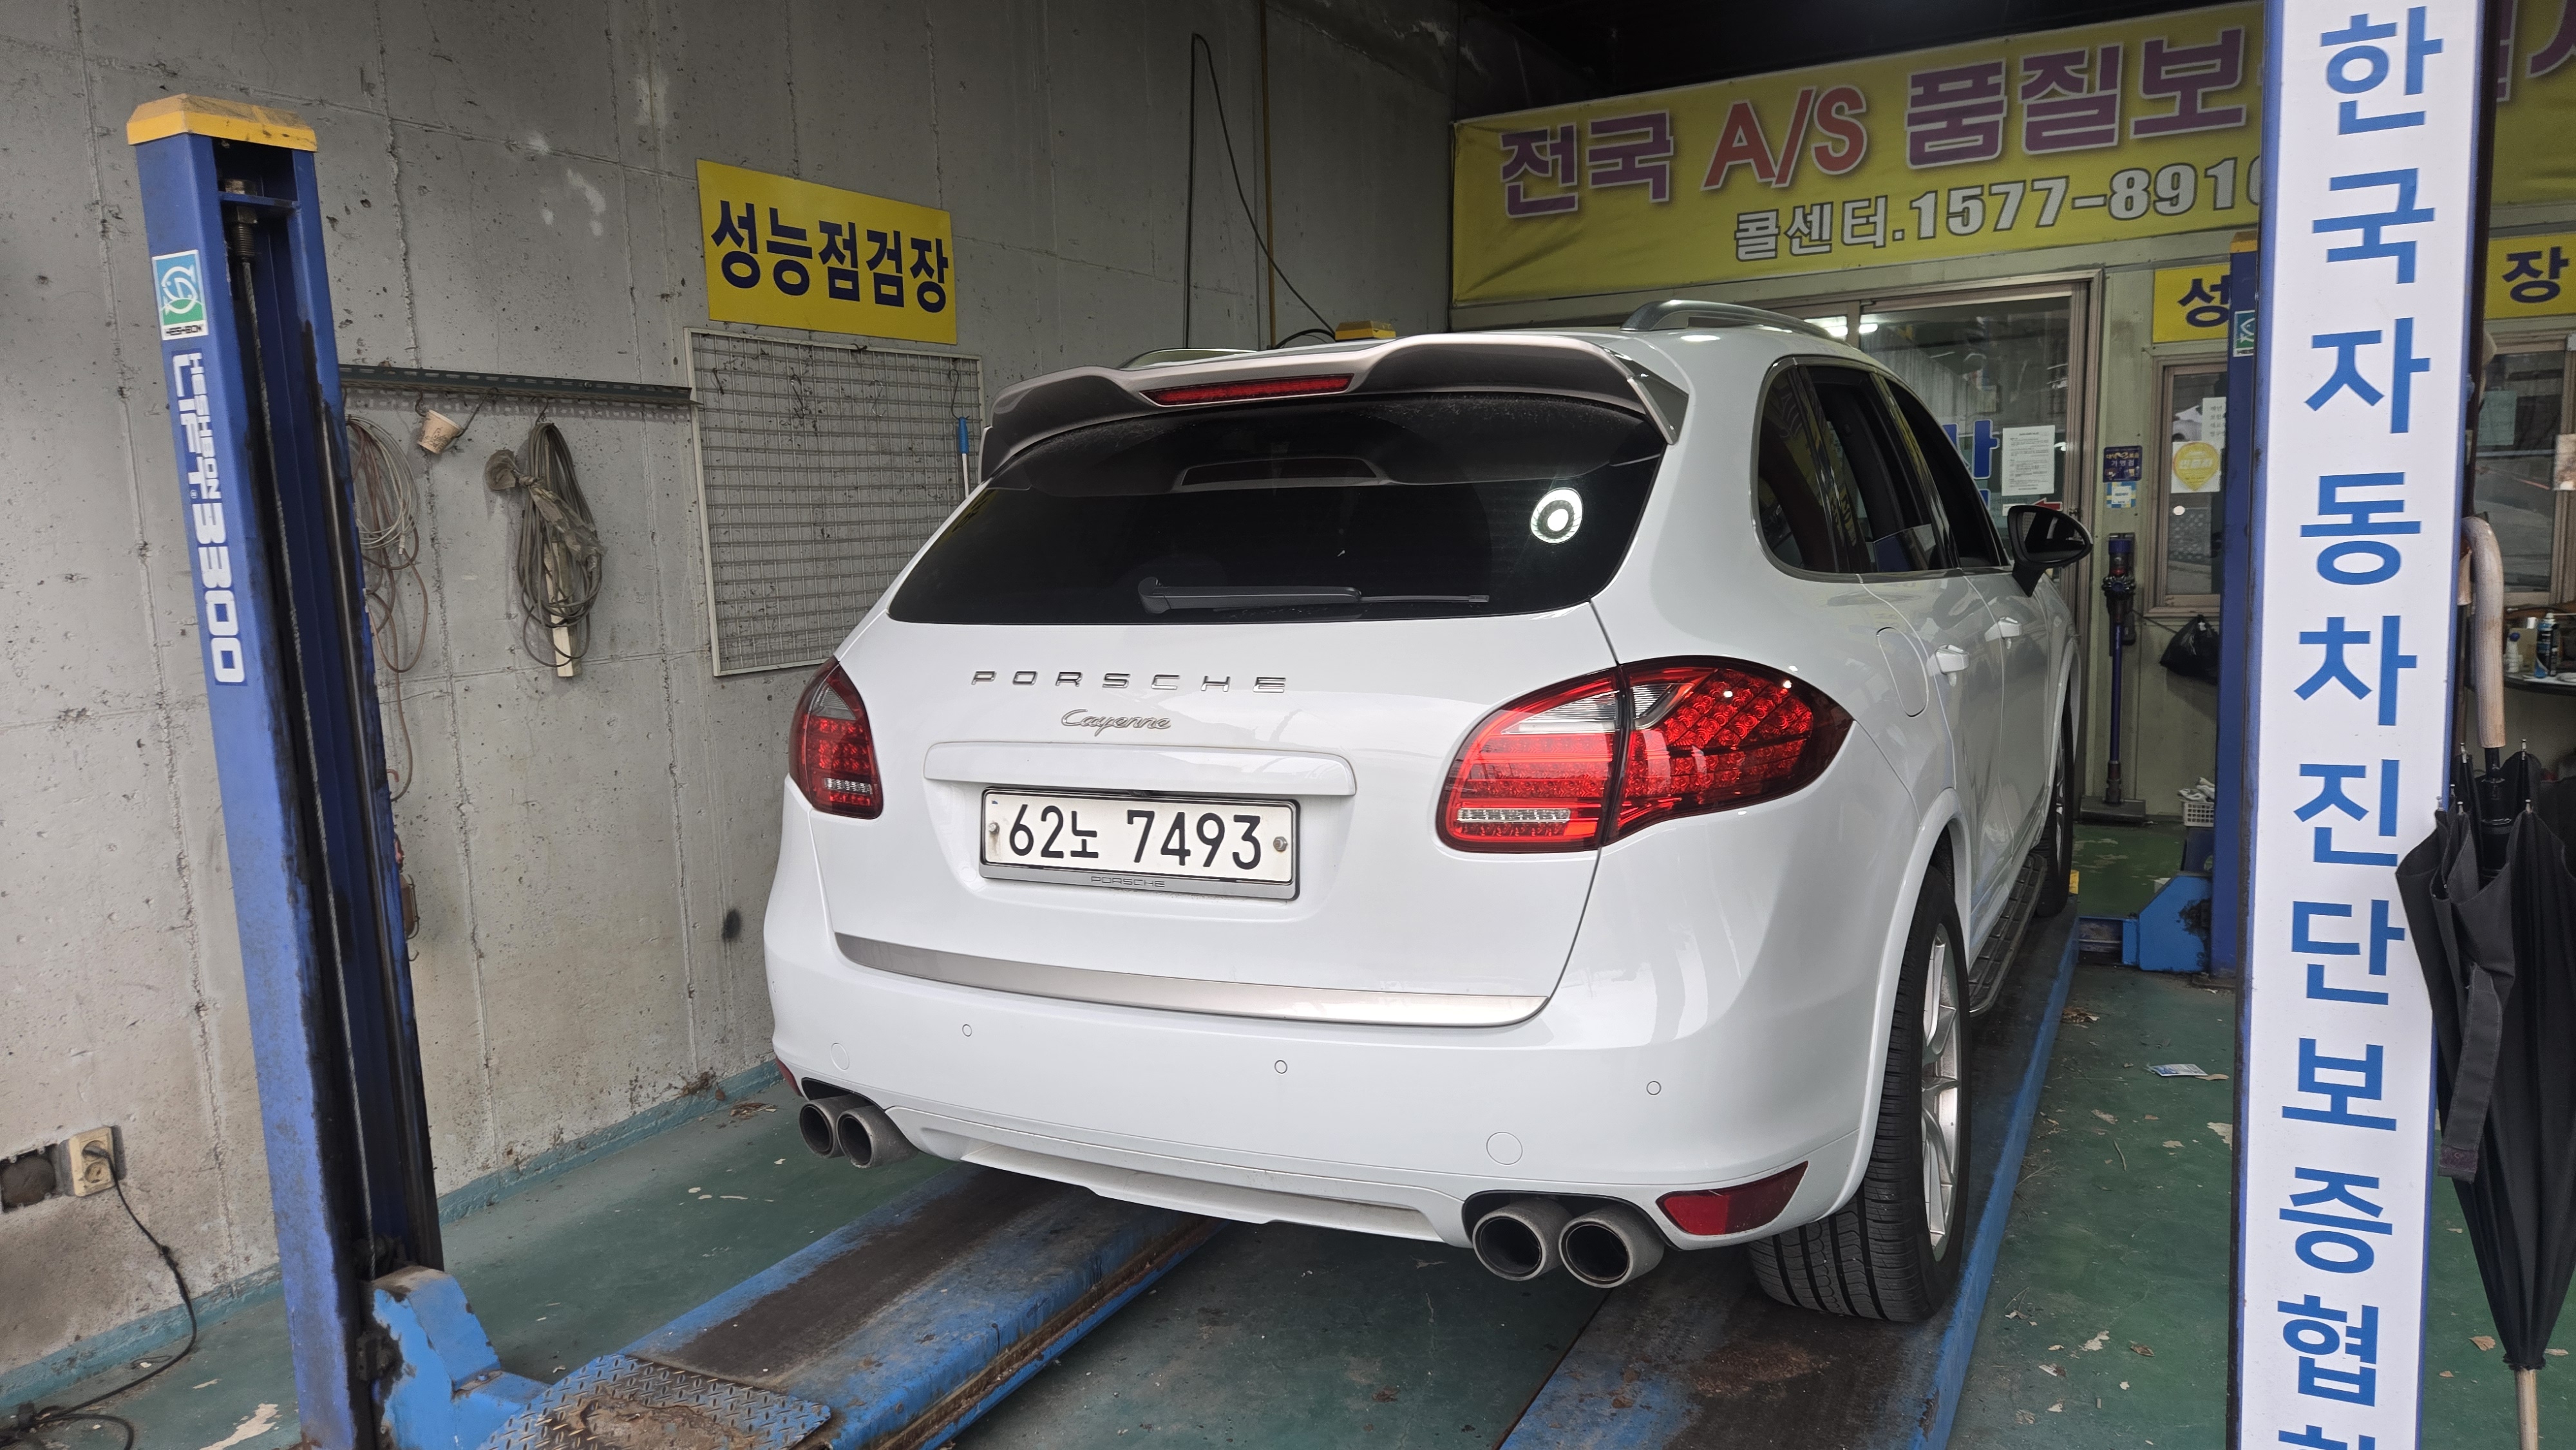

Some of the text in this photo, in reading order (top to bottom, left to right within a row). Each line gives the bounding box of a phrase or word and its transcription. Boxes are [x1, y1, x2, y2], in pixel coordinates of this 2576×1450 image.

[1499, 24, 2263, 219] 전국 A/S 품질보
[710, 200, 949, 314] 성능점검장
[189, 352, 222, 500] HESHBON
[172, 353, 247, 684] LIFT 3300
[971, 670, 1287, 693] PORSCHE
[1060, 708, 1172, 737] Cayenne
[1009, 804, 1262, 871] 62노 7493
[1090, 876, 1166, 889] PORSCHE
